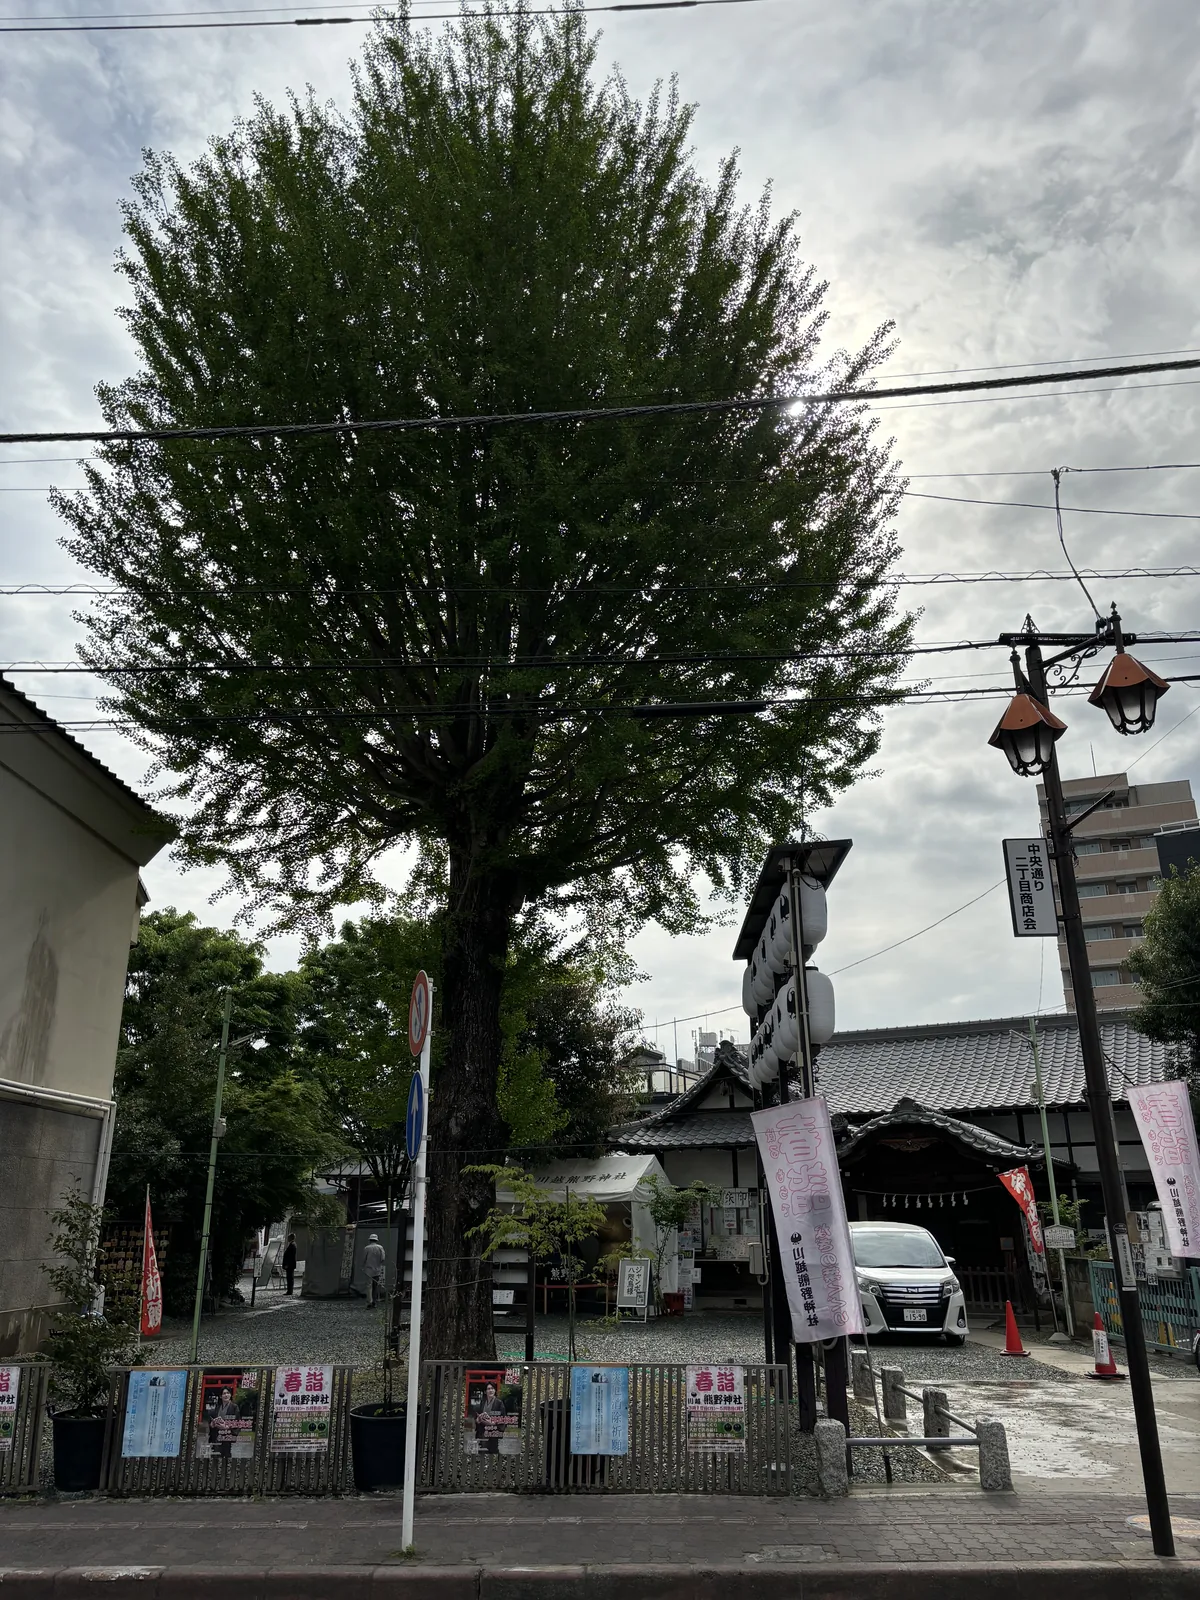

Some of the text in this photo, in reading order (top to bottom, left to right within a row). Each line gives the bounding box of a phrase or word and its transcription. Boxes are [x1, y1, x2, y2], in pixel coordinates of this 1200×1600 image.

[1027, 843, 1044, 891] 中央通り
[1015, 857, 1037, 930] 二丁目商店会
[535, 1171, 628, 1184] 川越熊野神社
[634, 1266, 642, 1292] ジャンボ
[284, 1371, 324, 1392] 春詣
[695, 1371, 735, 1392] 春詣
[291, 1394, 329, 1405] 熊野神社
[611, 1370, 623, 1452] 災厄消除祈願
[704, 1394, 742, 1405] 熊野神社
[163, 1373, 180, 1453] 災厄消除祈願
